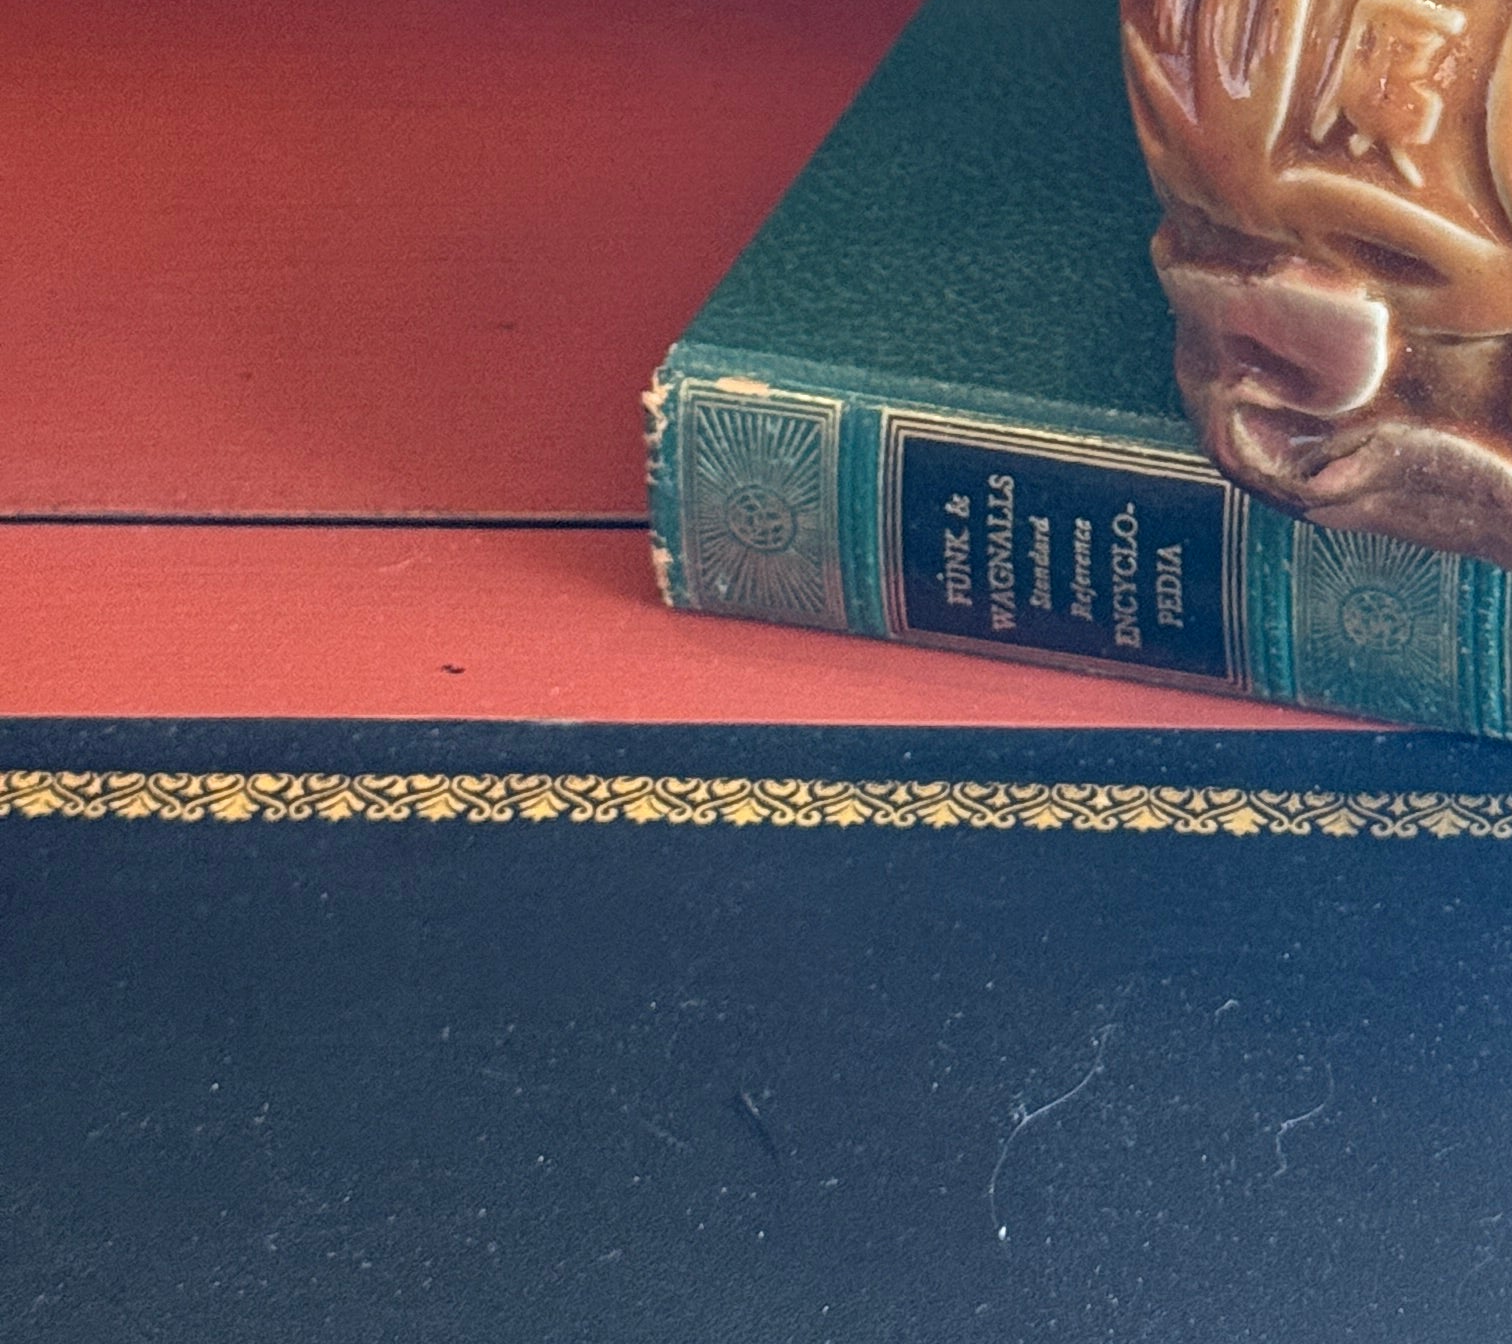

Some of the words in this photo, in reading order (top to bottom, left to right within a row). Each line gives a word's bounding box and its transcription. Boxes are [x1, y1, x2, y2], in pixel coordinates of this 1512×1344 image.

[945, 493, 971, 519] &
[987, 474, 1016, 632] WAGNALLS
[944, 527, 972, 607] FUNK
[1028, 515, 1051, 609] Standard
[1070, 517, 1096, 621] Reference
[1111, 502, 1142, 649] ENCYCLO-
[1156, 543, 1184, 628] PEDIA
